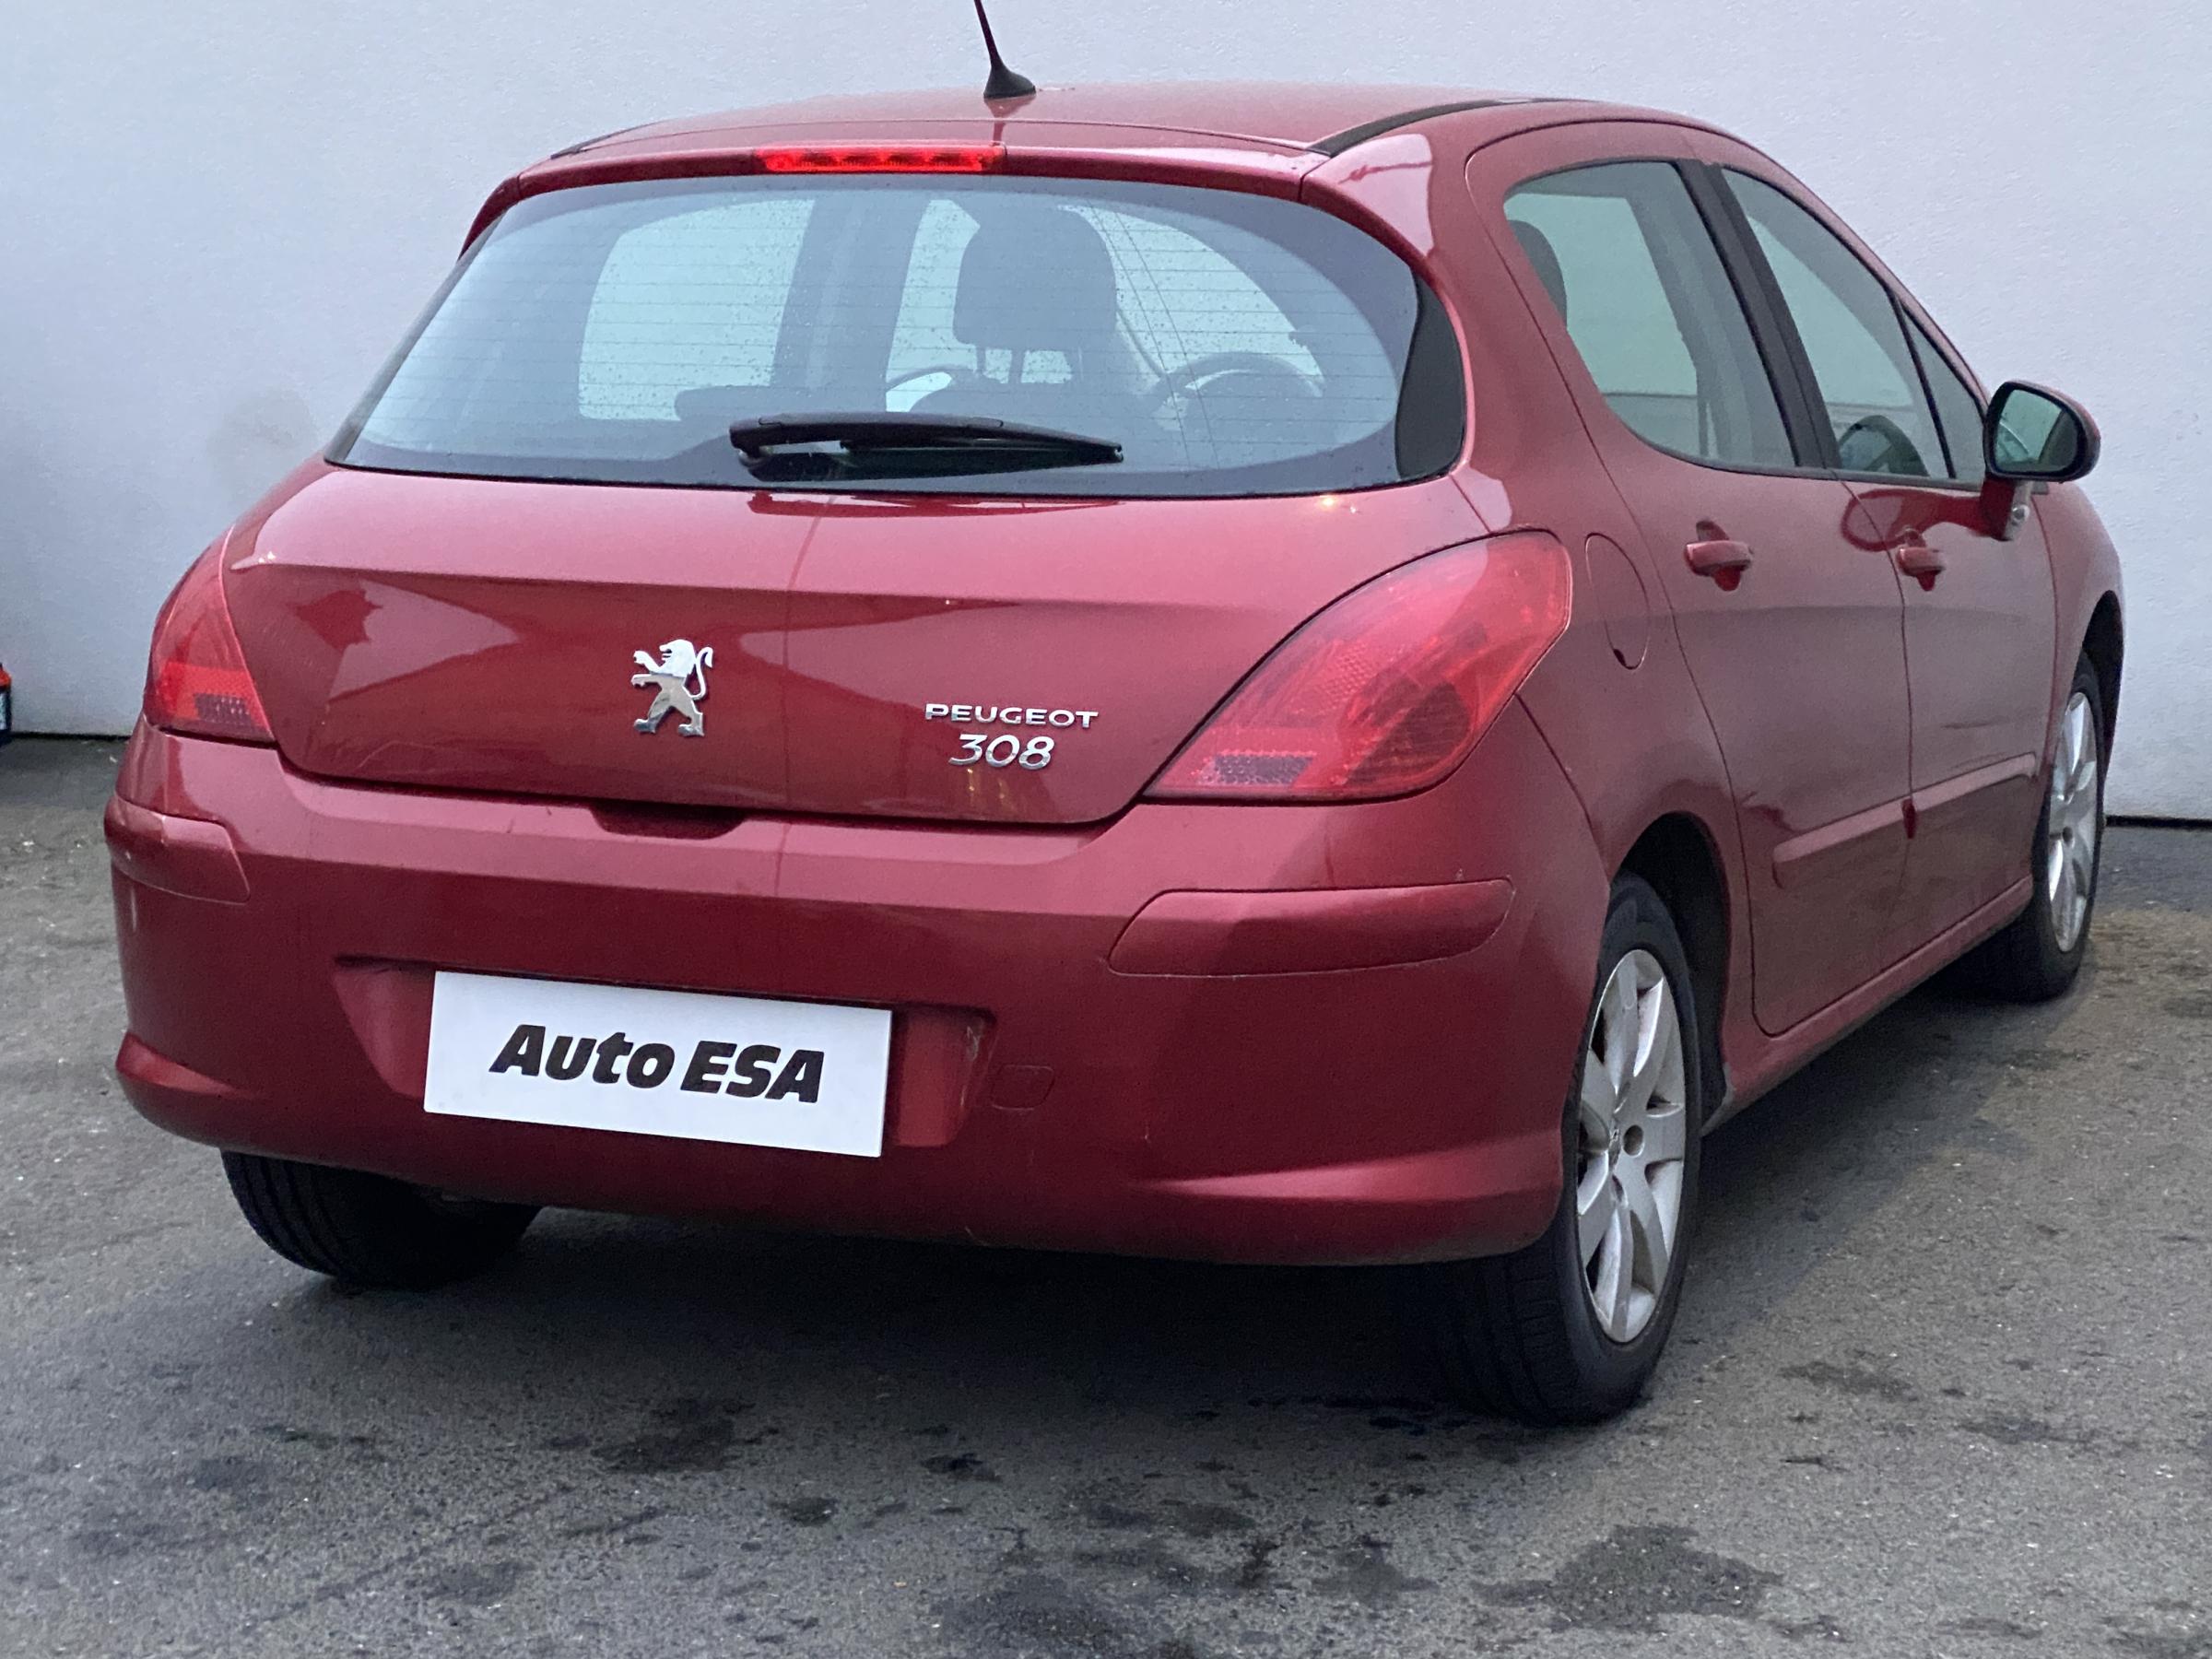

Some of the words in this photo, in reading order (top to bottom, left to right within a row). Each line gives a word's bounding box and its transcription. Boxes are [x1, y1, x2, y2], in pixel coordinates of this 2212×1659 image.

[925, 703, 1098, 728] PEUGEOT
[949, 735, 1055, 770] 308
[489, 1024, 676, 1088] Auto
[680, 1041, 825, 1103] ESA
